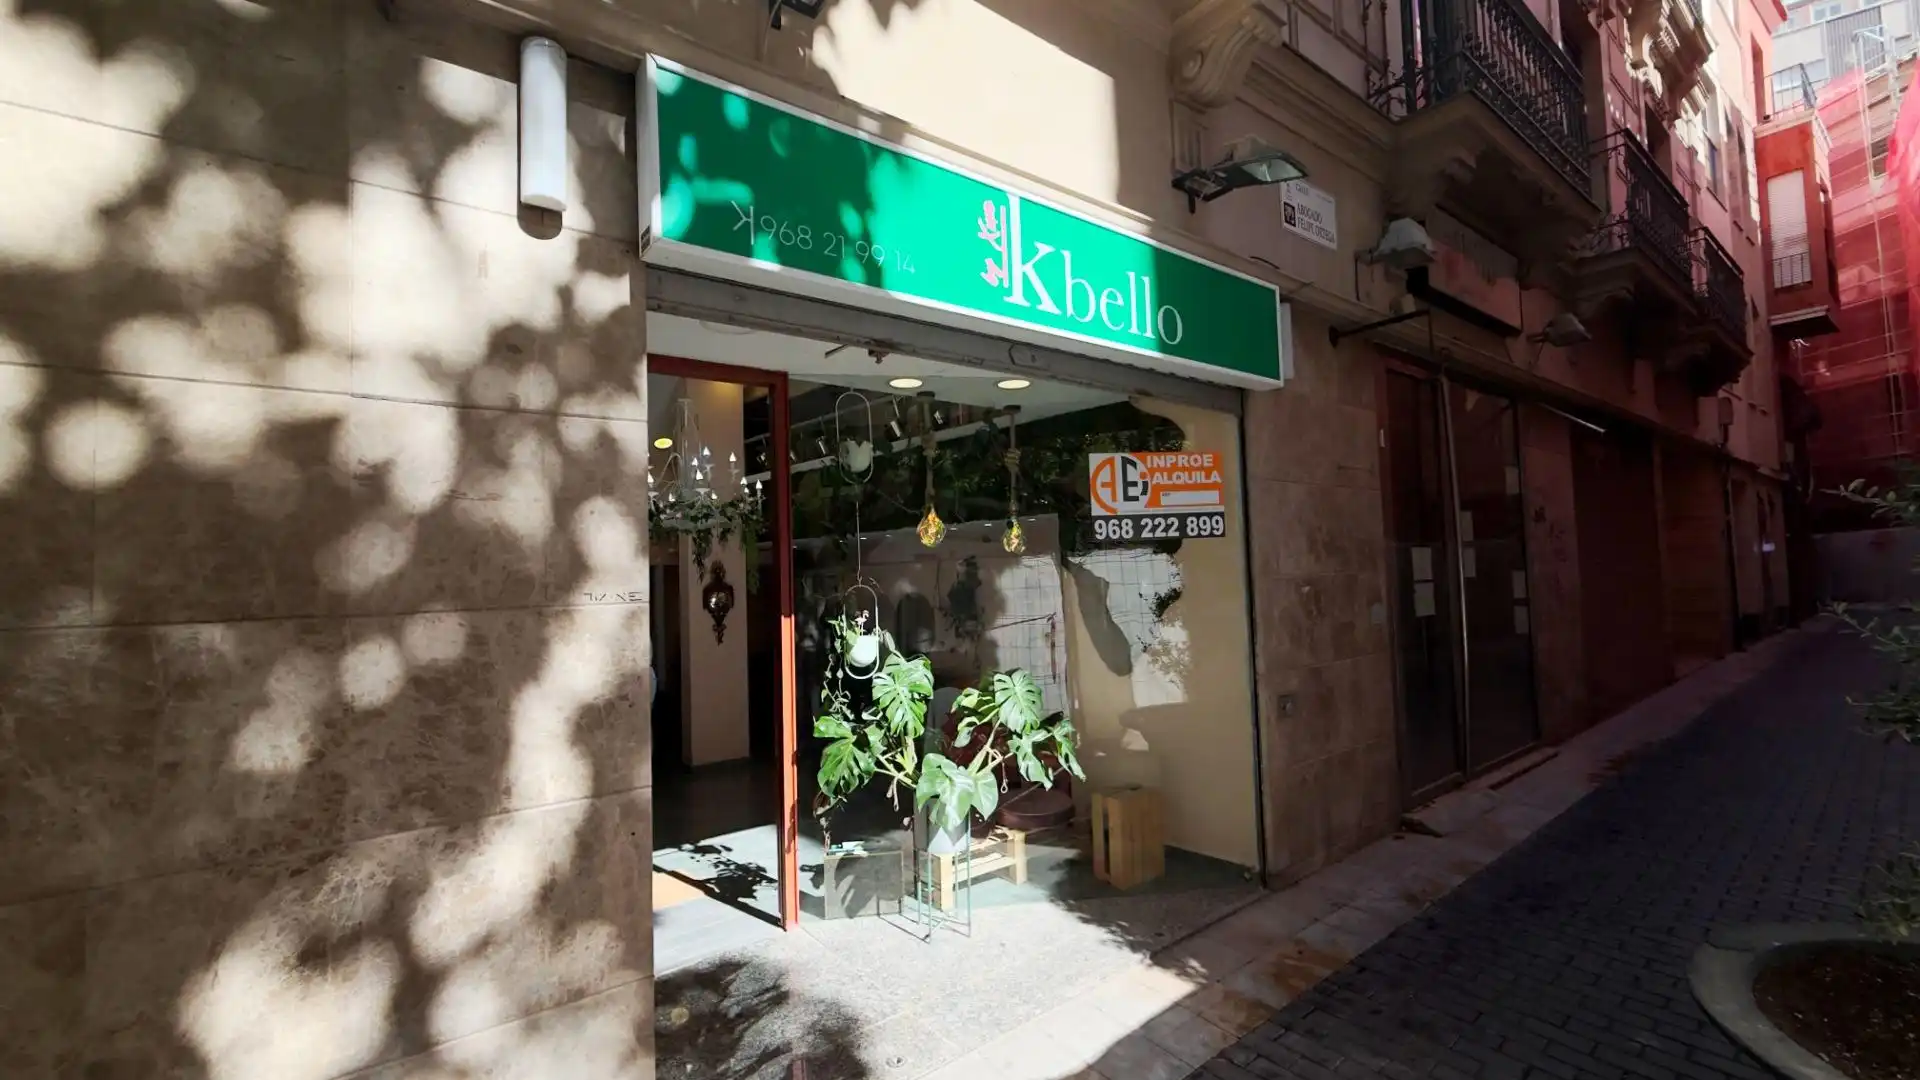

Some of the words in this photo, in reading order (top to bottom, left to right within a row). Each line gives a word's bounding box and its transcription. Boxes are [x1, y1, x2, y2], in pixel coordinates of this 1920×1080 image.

[760, 215, 813, 250] 968
[823, 232, 845, 260] 21
[855, 240, 885, 269] 99
[896, 249, 917, 275] 14
[1147, 454, 1214, 468] INPROE
[1152, 470, 1222, 484] ALQUILA
[1094, 518, 1134, 540] 968
[1140, 517, 1180, 538] 222
[1186, 515, 1224, 536] 899
